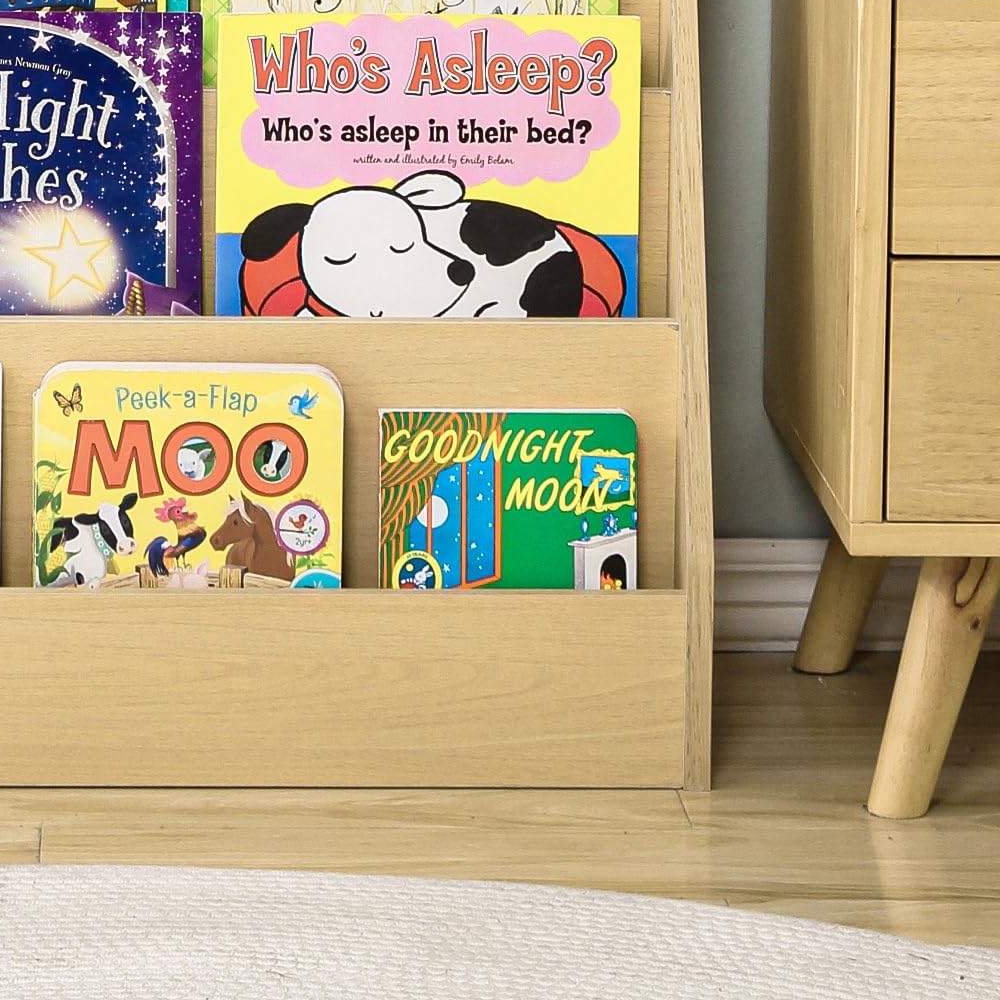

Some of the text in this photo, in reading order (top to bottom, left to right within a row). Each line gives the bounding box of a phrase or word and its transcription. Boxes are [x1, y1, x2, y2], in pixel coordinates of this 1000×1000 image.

[14, 56, 50, 71] Newman
[247, 26, 617, 116] Who's Asleep?
[262, 116, 592, 150] Who's asleep in their bed?
[353, 154, 381, 164] written
[384, 154, 399, 164] and
[402, 154, 445, 164] illustrated
[448, 154, 457, 168] by
[460, 154, 484, 168] Emily
[114, 383, 258, 417] Peek-a-Flap
[67, 419, 309, 498] MOO
[384, 429, 594, 464] GOODNIGHT
[505, 477, 613, 513] MOON
